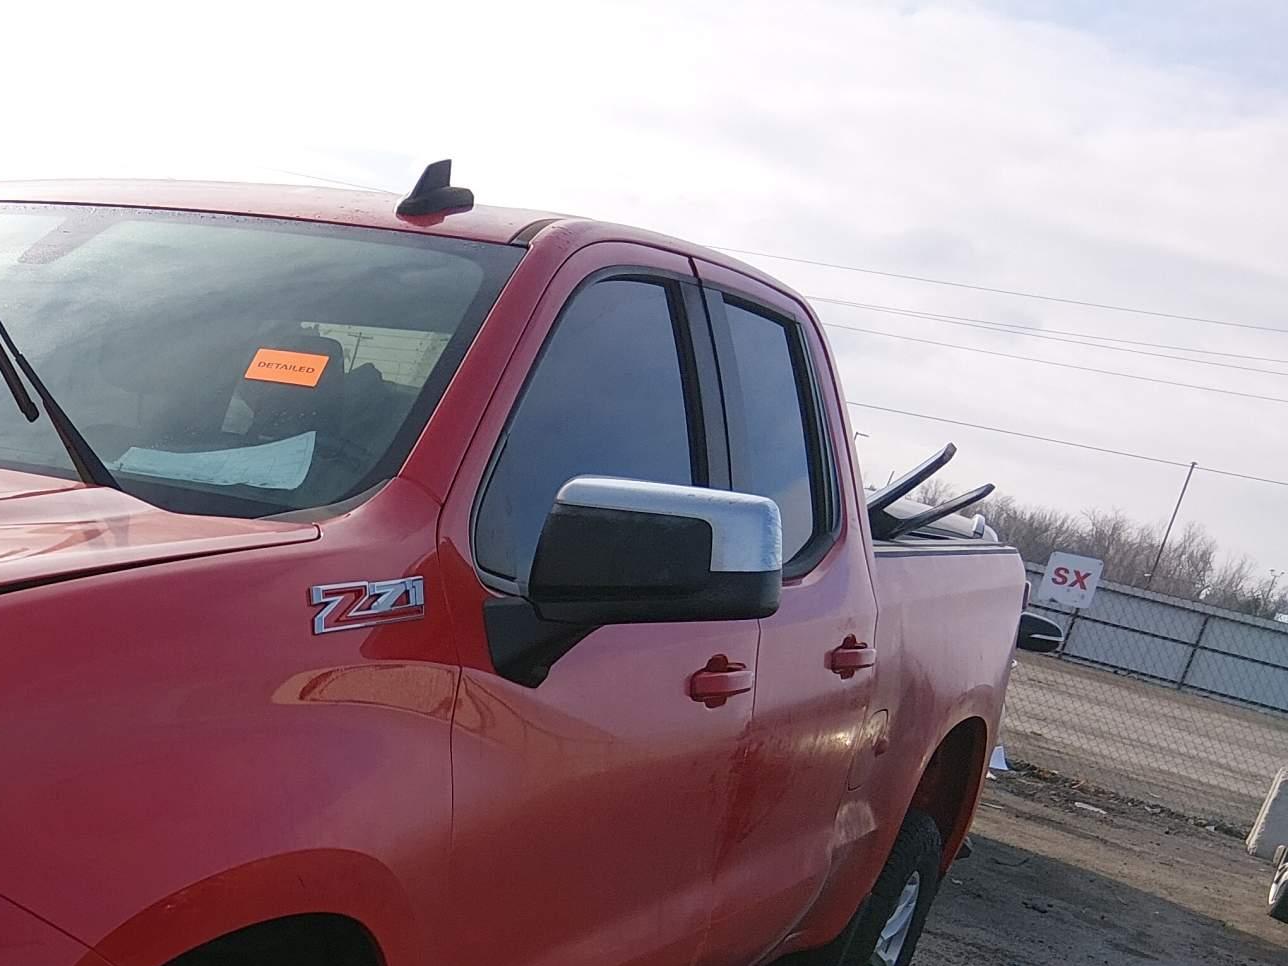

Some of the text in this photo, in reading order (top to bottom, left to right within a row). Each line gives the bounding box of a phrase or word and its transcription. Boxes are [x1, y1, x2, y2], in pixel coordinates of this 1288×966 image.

[257, 361, 316, 374] DETAILED
[1051, 566, 1092, 591] SX
[309, 576, 425, 635] Z71
